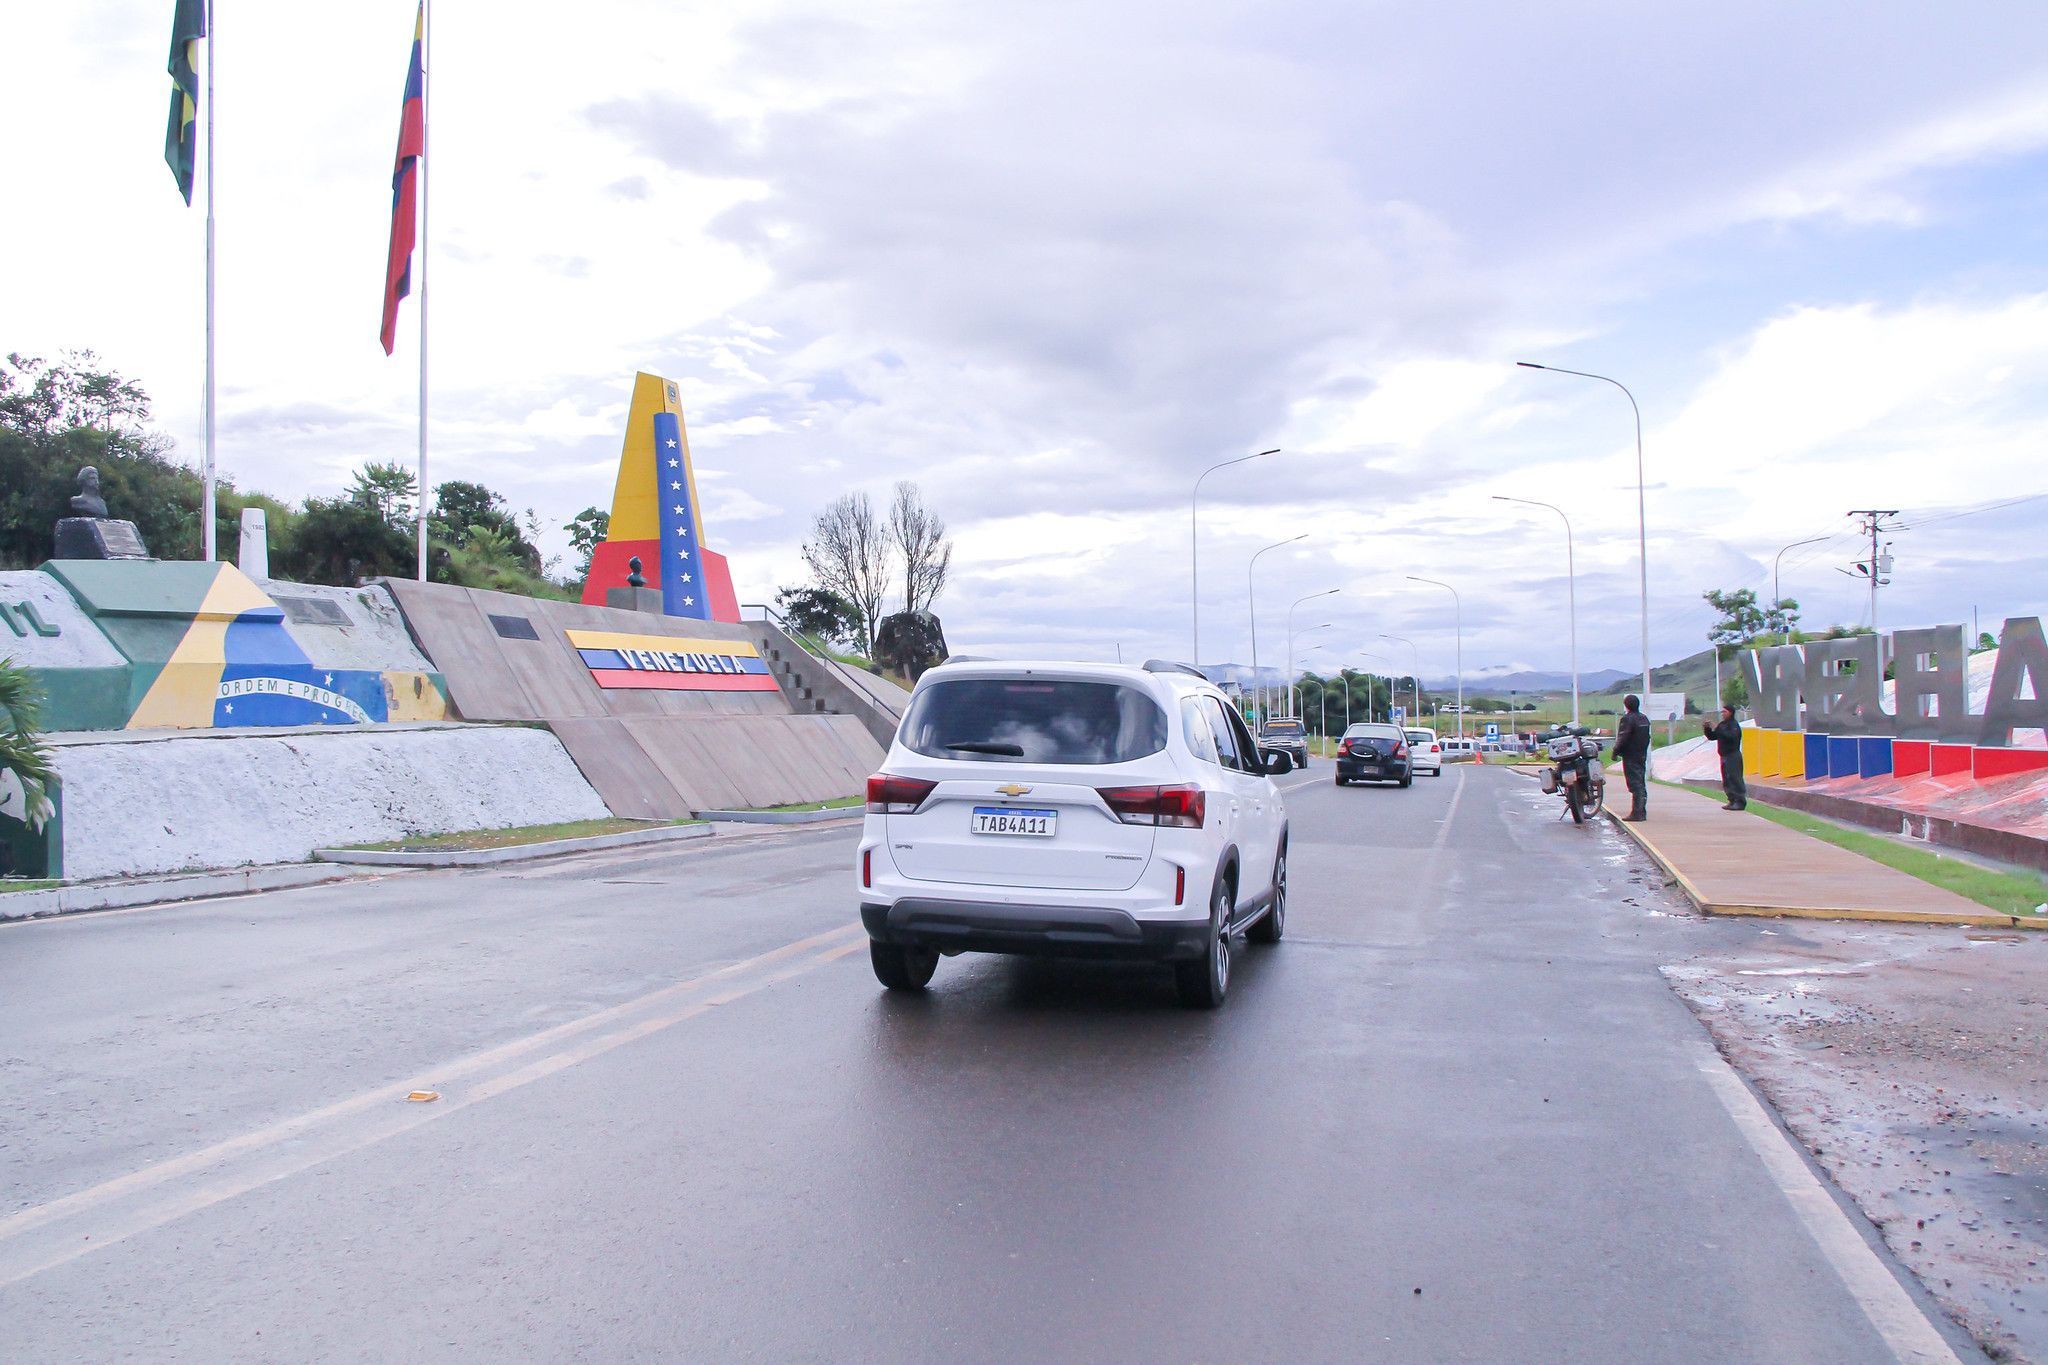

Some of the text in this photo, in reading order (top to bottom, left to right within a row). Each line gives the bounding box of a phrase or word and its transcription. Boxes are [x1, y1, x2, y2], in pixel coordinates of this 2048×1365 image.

[616, 648, 747, 674] VENEZUELA
[221, 679, 278, 696] ORDEM
[288, 683, 293, 694] E
[980, 816, 1046, 834] TAB4A11
